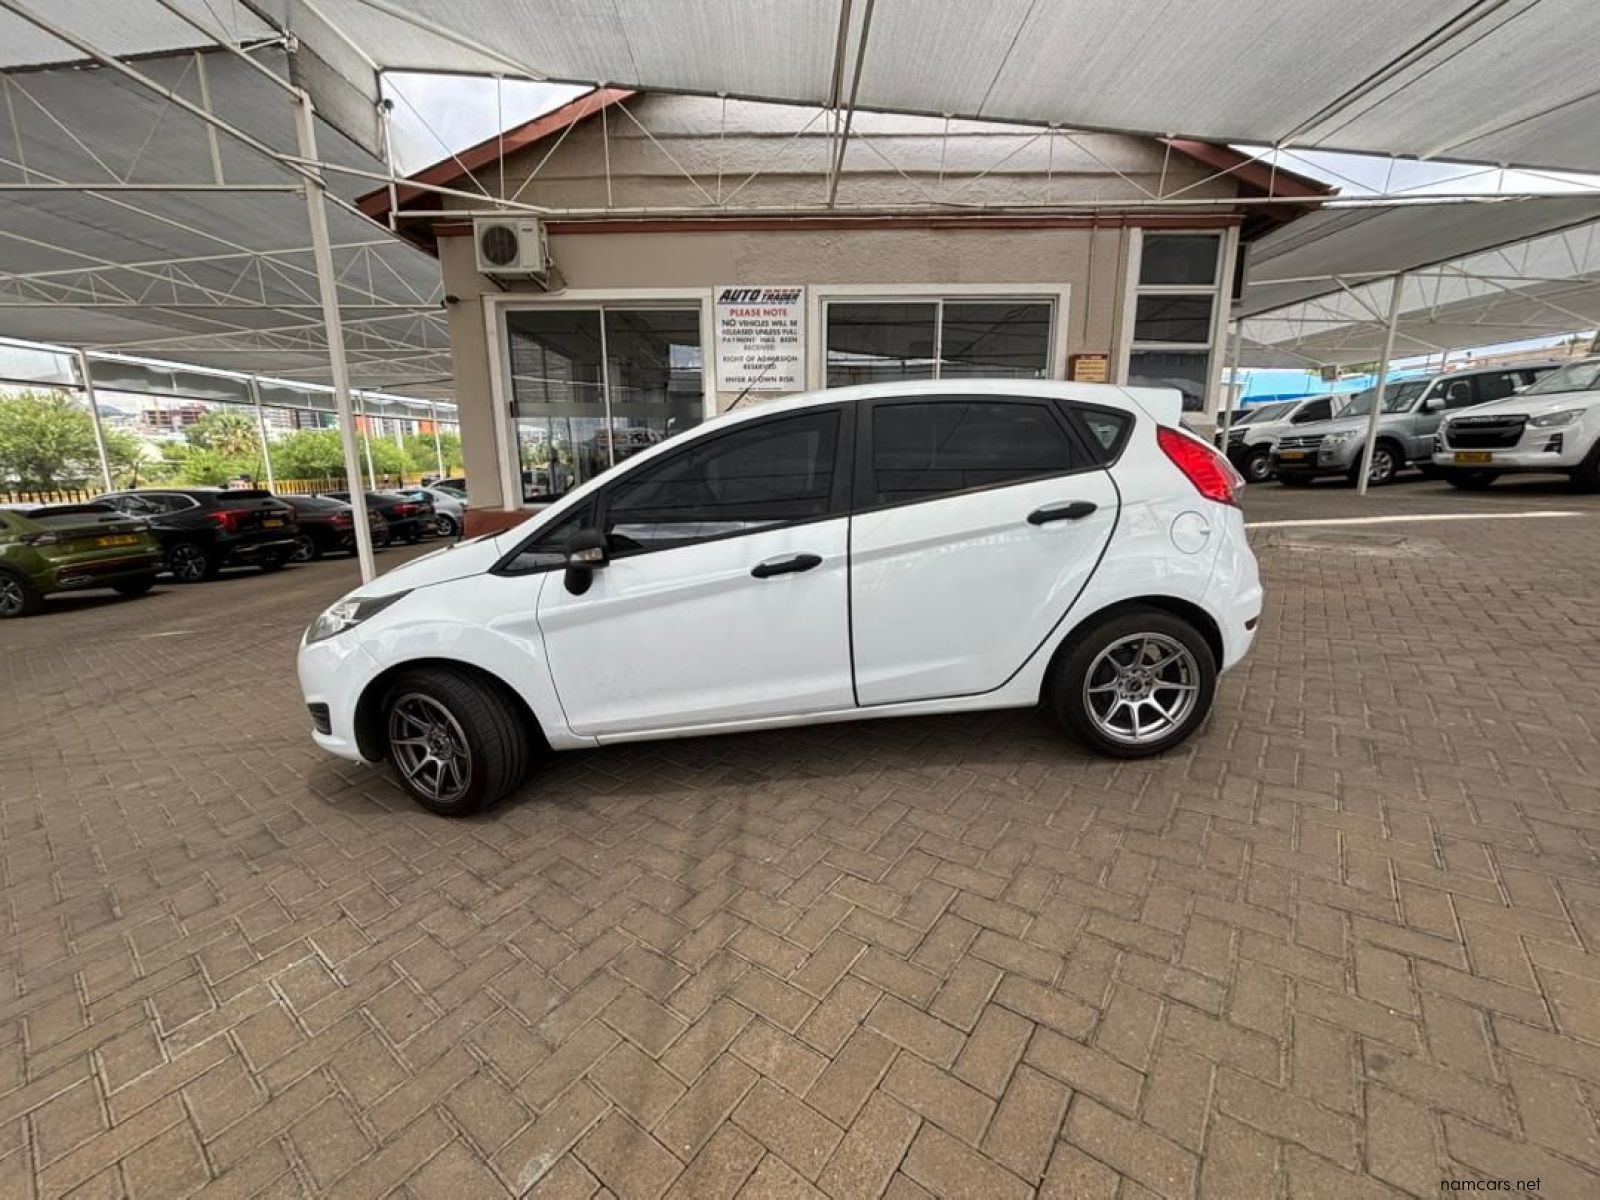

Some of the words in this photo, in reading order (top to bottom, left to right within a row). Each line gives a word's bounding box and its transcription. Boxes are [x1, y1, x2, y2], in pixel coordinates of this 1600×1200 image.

[719, 289, 762, 302] AUTO
[730, 308, 761, 317] PLEASE
[763, 308, 787, 317] NOTE
[722, 319, 736, 327] NO
[738, 319, 769, 327] VEHICLES
[771, 319, 787, 327] WILL
[789, 319, 798, 327] BE
